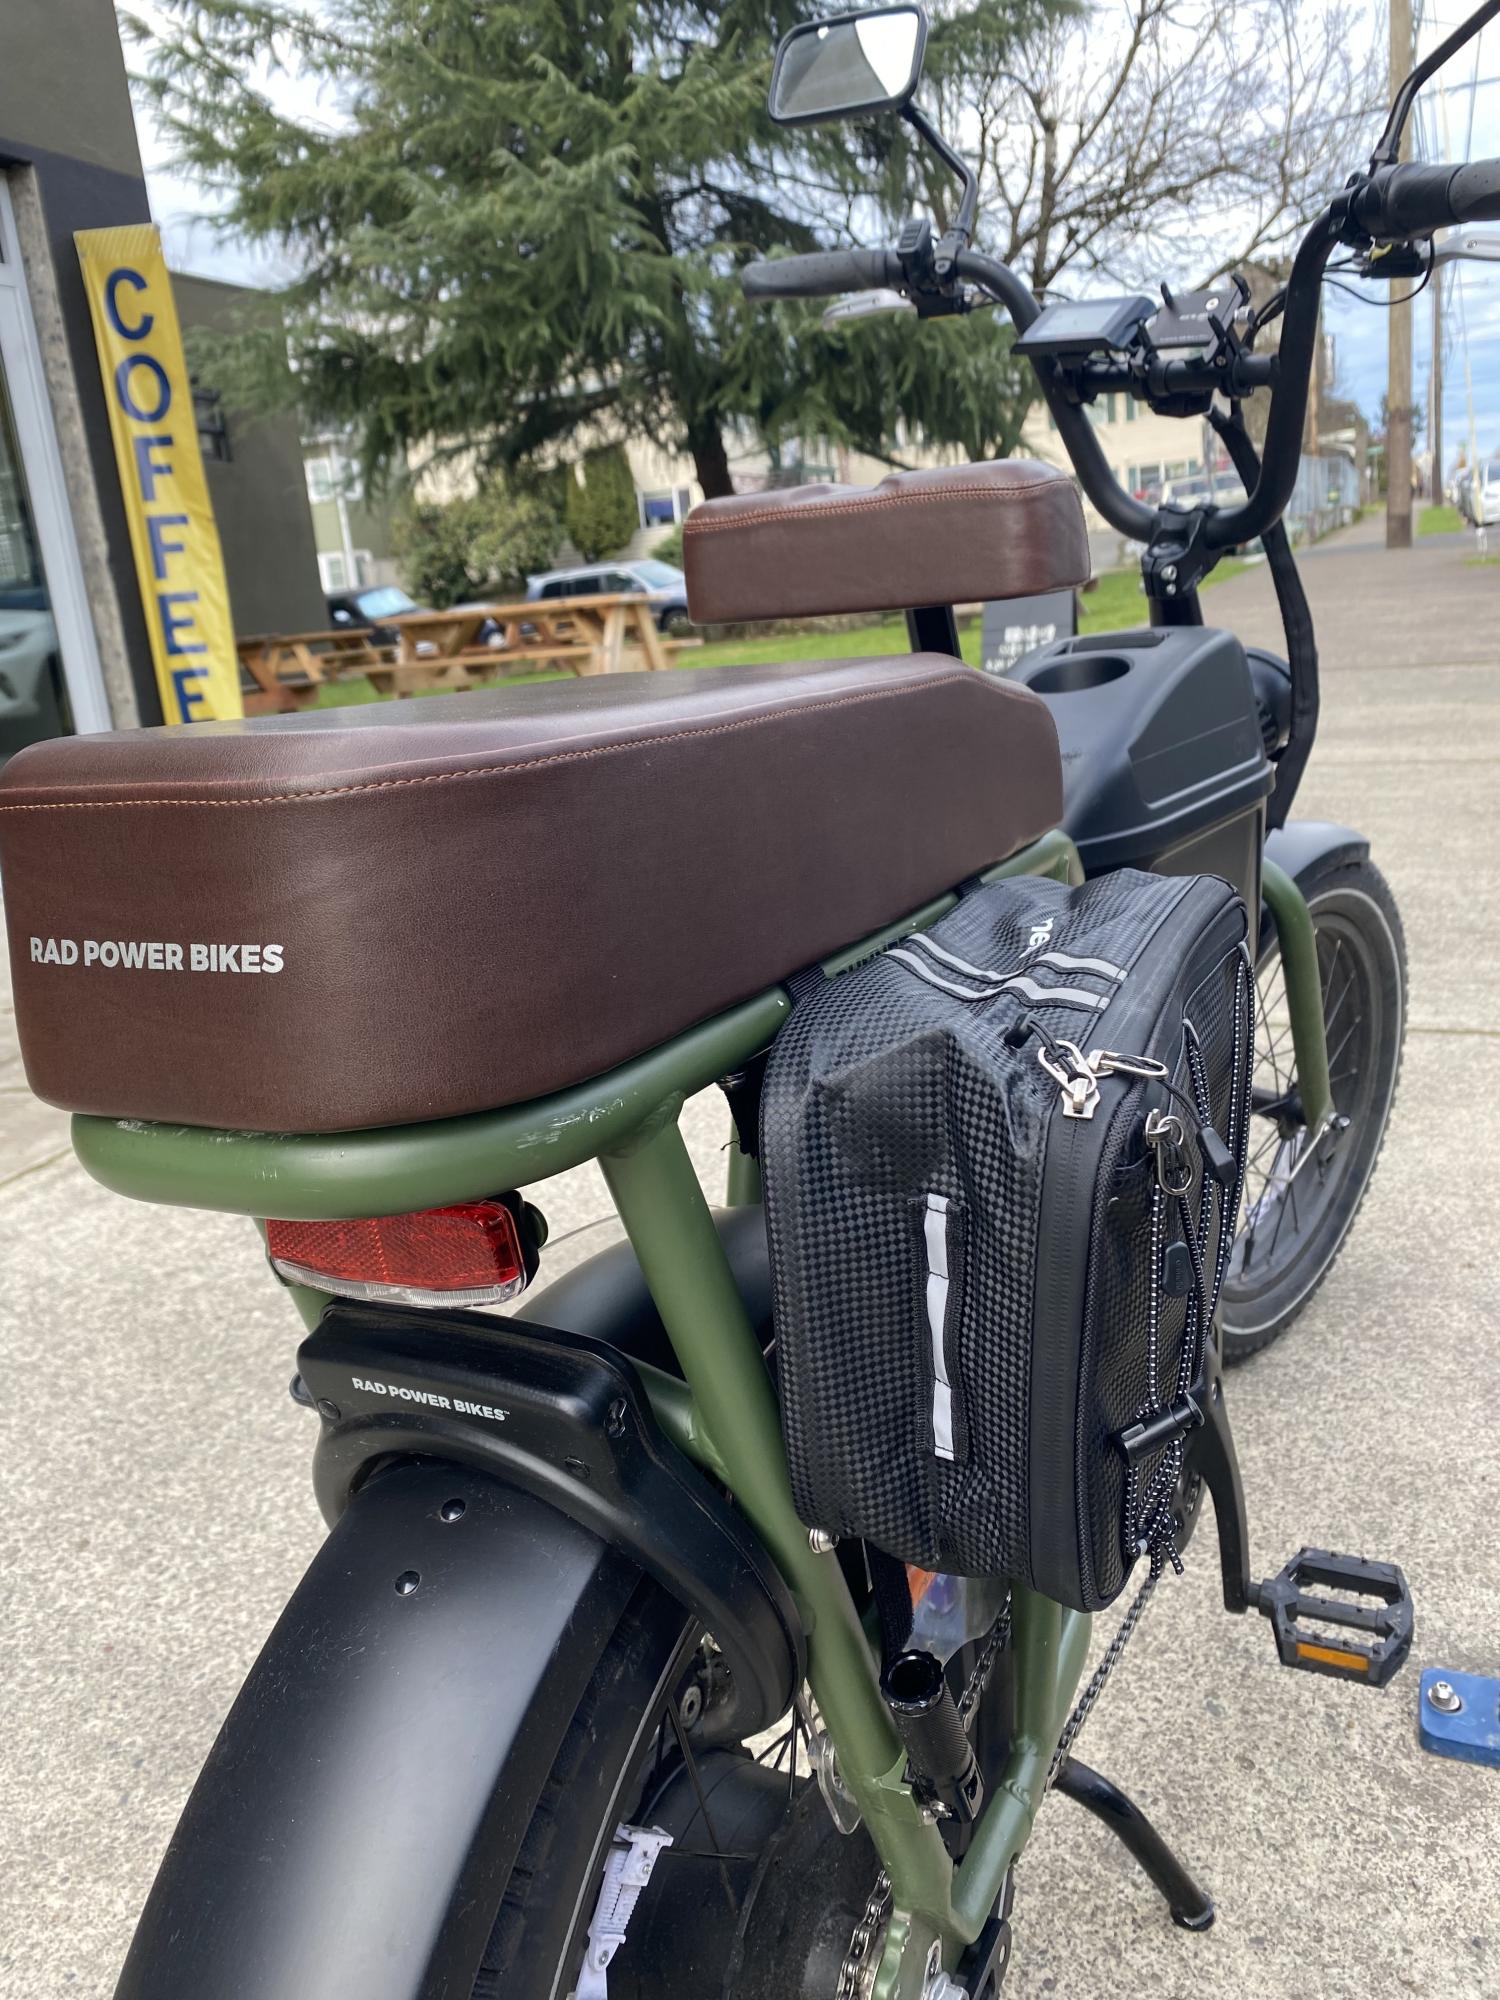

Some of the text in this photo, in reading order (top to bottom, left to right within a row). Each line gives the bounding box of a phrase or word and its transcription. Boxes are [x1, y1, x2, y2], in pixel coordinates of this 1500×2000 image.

[105, 267, 212, 724] COFFEE
[29, 936, 285, 974] RAD POWER BIKES
[351, 1377, 387, 1395] RAD
[388, 1385, 452, 1410] POWER
